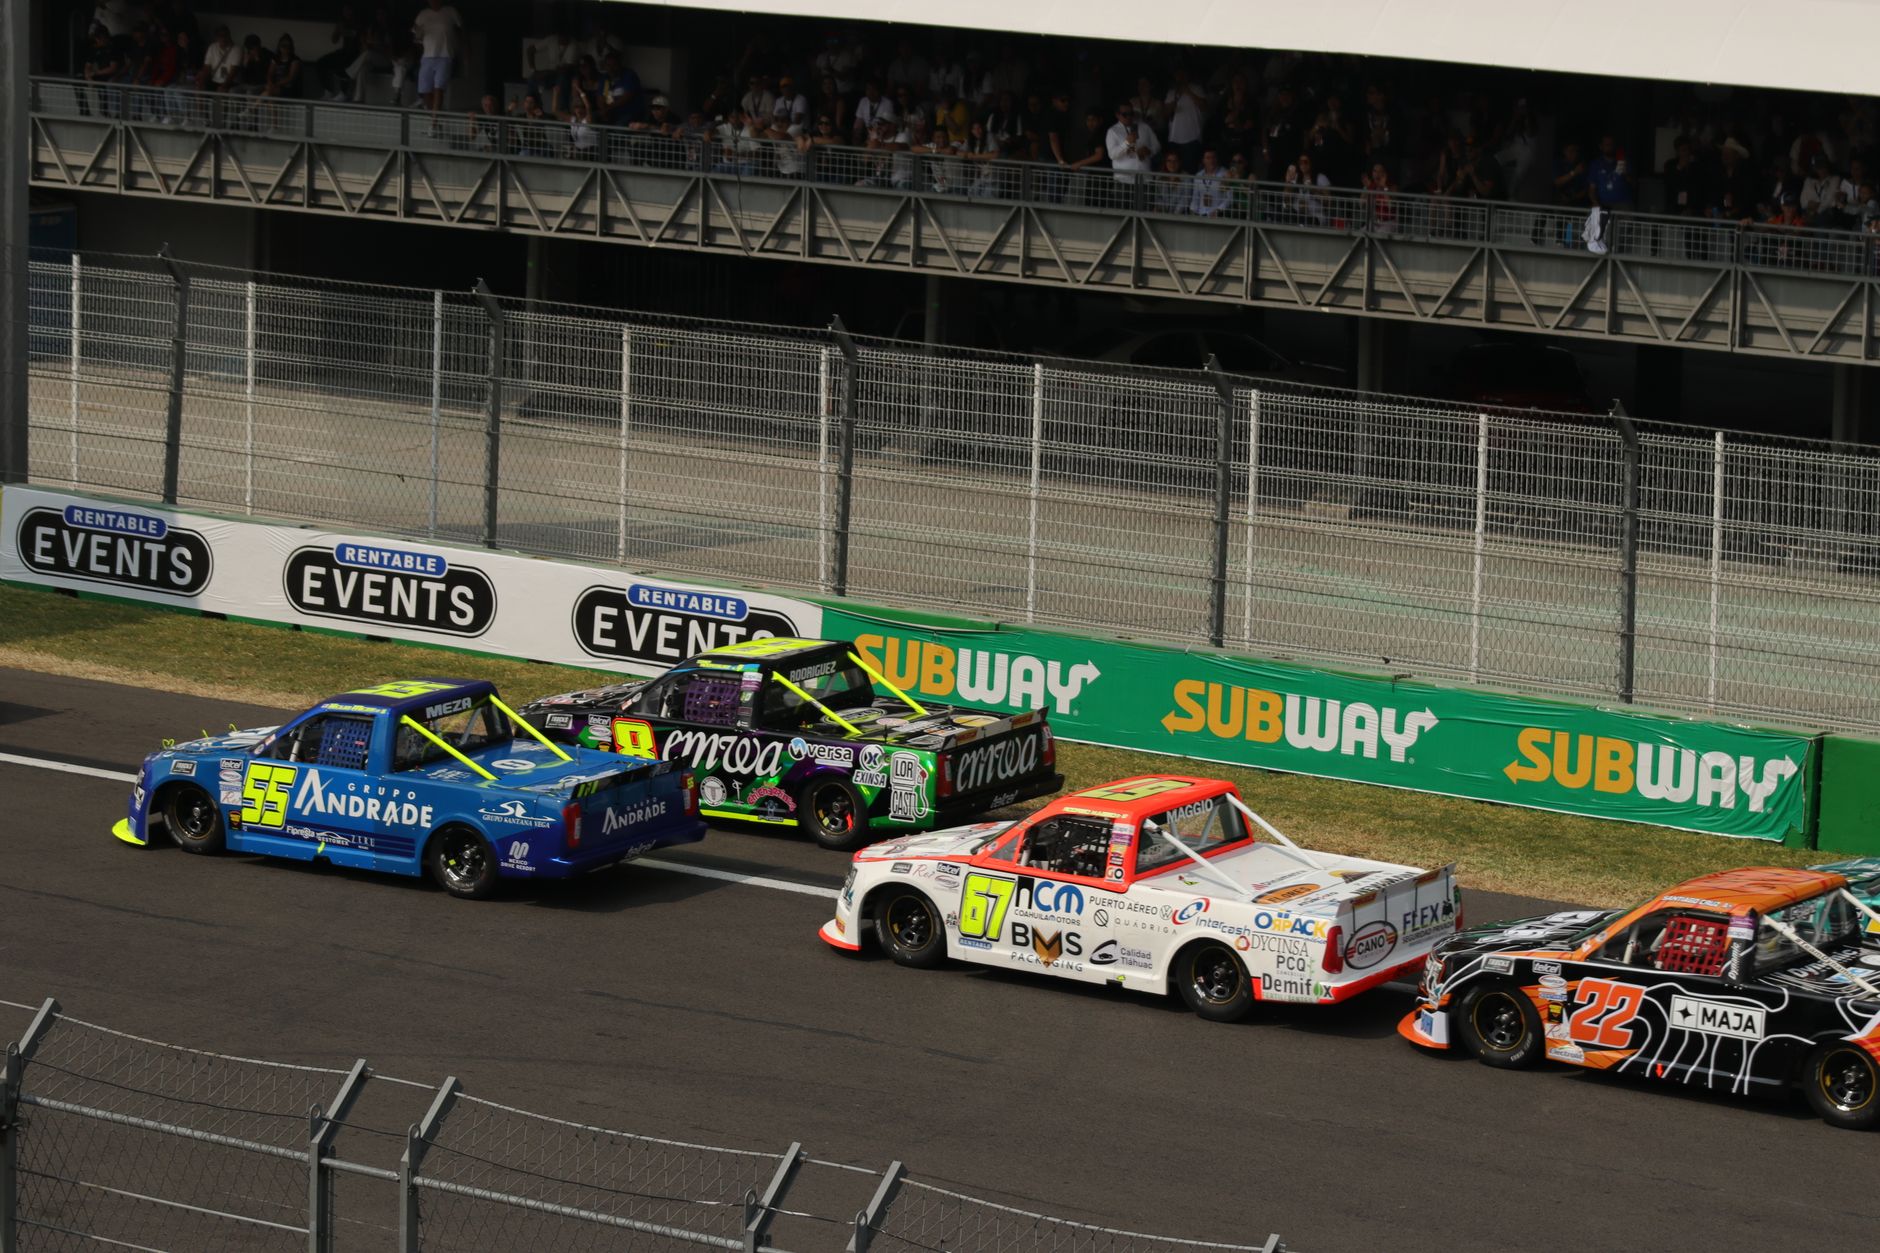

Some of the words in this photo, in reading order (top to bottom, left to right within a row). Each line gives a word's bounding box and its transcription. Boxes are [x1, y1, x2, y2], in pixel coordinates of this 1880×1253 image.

[72, 509, 158, 535] RENTABLE
[33, 525, 194, 587] EVENTS
[343, 543, 438, 574] RENTABLE
[302, 565, 476, 628] EVENTS
[637, 587, 739, 616] RENTABLE
[592, 604, 776, 658] EVENT
[789, 661, 837, 682] RODRIGUEZ
[853, 633, 1101, 715] SUBWAY
[426, 697, 472, 719] MEZA
[1161, 678, 1440, 763] SUBWAY
[221, 760, 242, 769] telcel
[895, 759, 913, 778] LOR
[1503, 727, 1798, 813] SUBWAY
[348, 783, 416, 800] GRUPO
[855, 771, 886, 787] EXINSA
[242, 761, 298, 830] 55
[294, 768, 434, 828] ANDRADE
[482, 814, 503, 823] GRUPO
[503, 817, 533, 827] SANTANA
[534, 821, 551, 829] VEGA
[601, 801, 667, 835] ANDRADE
[1166, 799, 1214, 825] MAGGIO
[937, 863, 960, 875] telcel
[959, 871, 1017, 941] 67
[1089, 895, 1125, 910] PUERTO
[1127, 899, 1158, 916] AÉREO
[1402, 902, 1440, 935] FLEX
[1011, 922, 1082, 956] BMS
[1195, 916, 1251, 937] Intercash
[1120, 948, 1151, 960] Calidad
[1251, 934, 1310, 957] DYCINSA
[1357, 935, 1385, 955] CANO
[1121, 956, 1153, 970] Tláhuac
[1276, 955, 1306, 973] PCQ
[1534, 962, 1560, 974] telcel
[1569, 977, 1647, 1049] 22
[1701, 1006, 1757, 1034] MAJA
